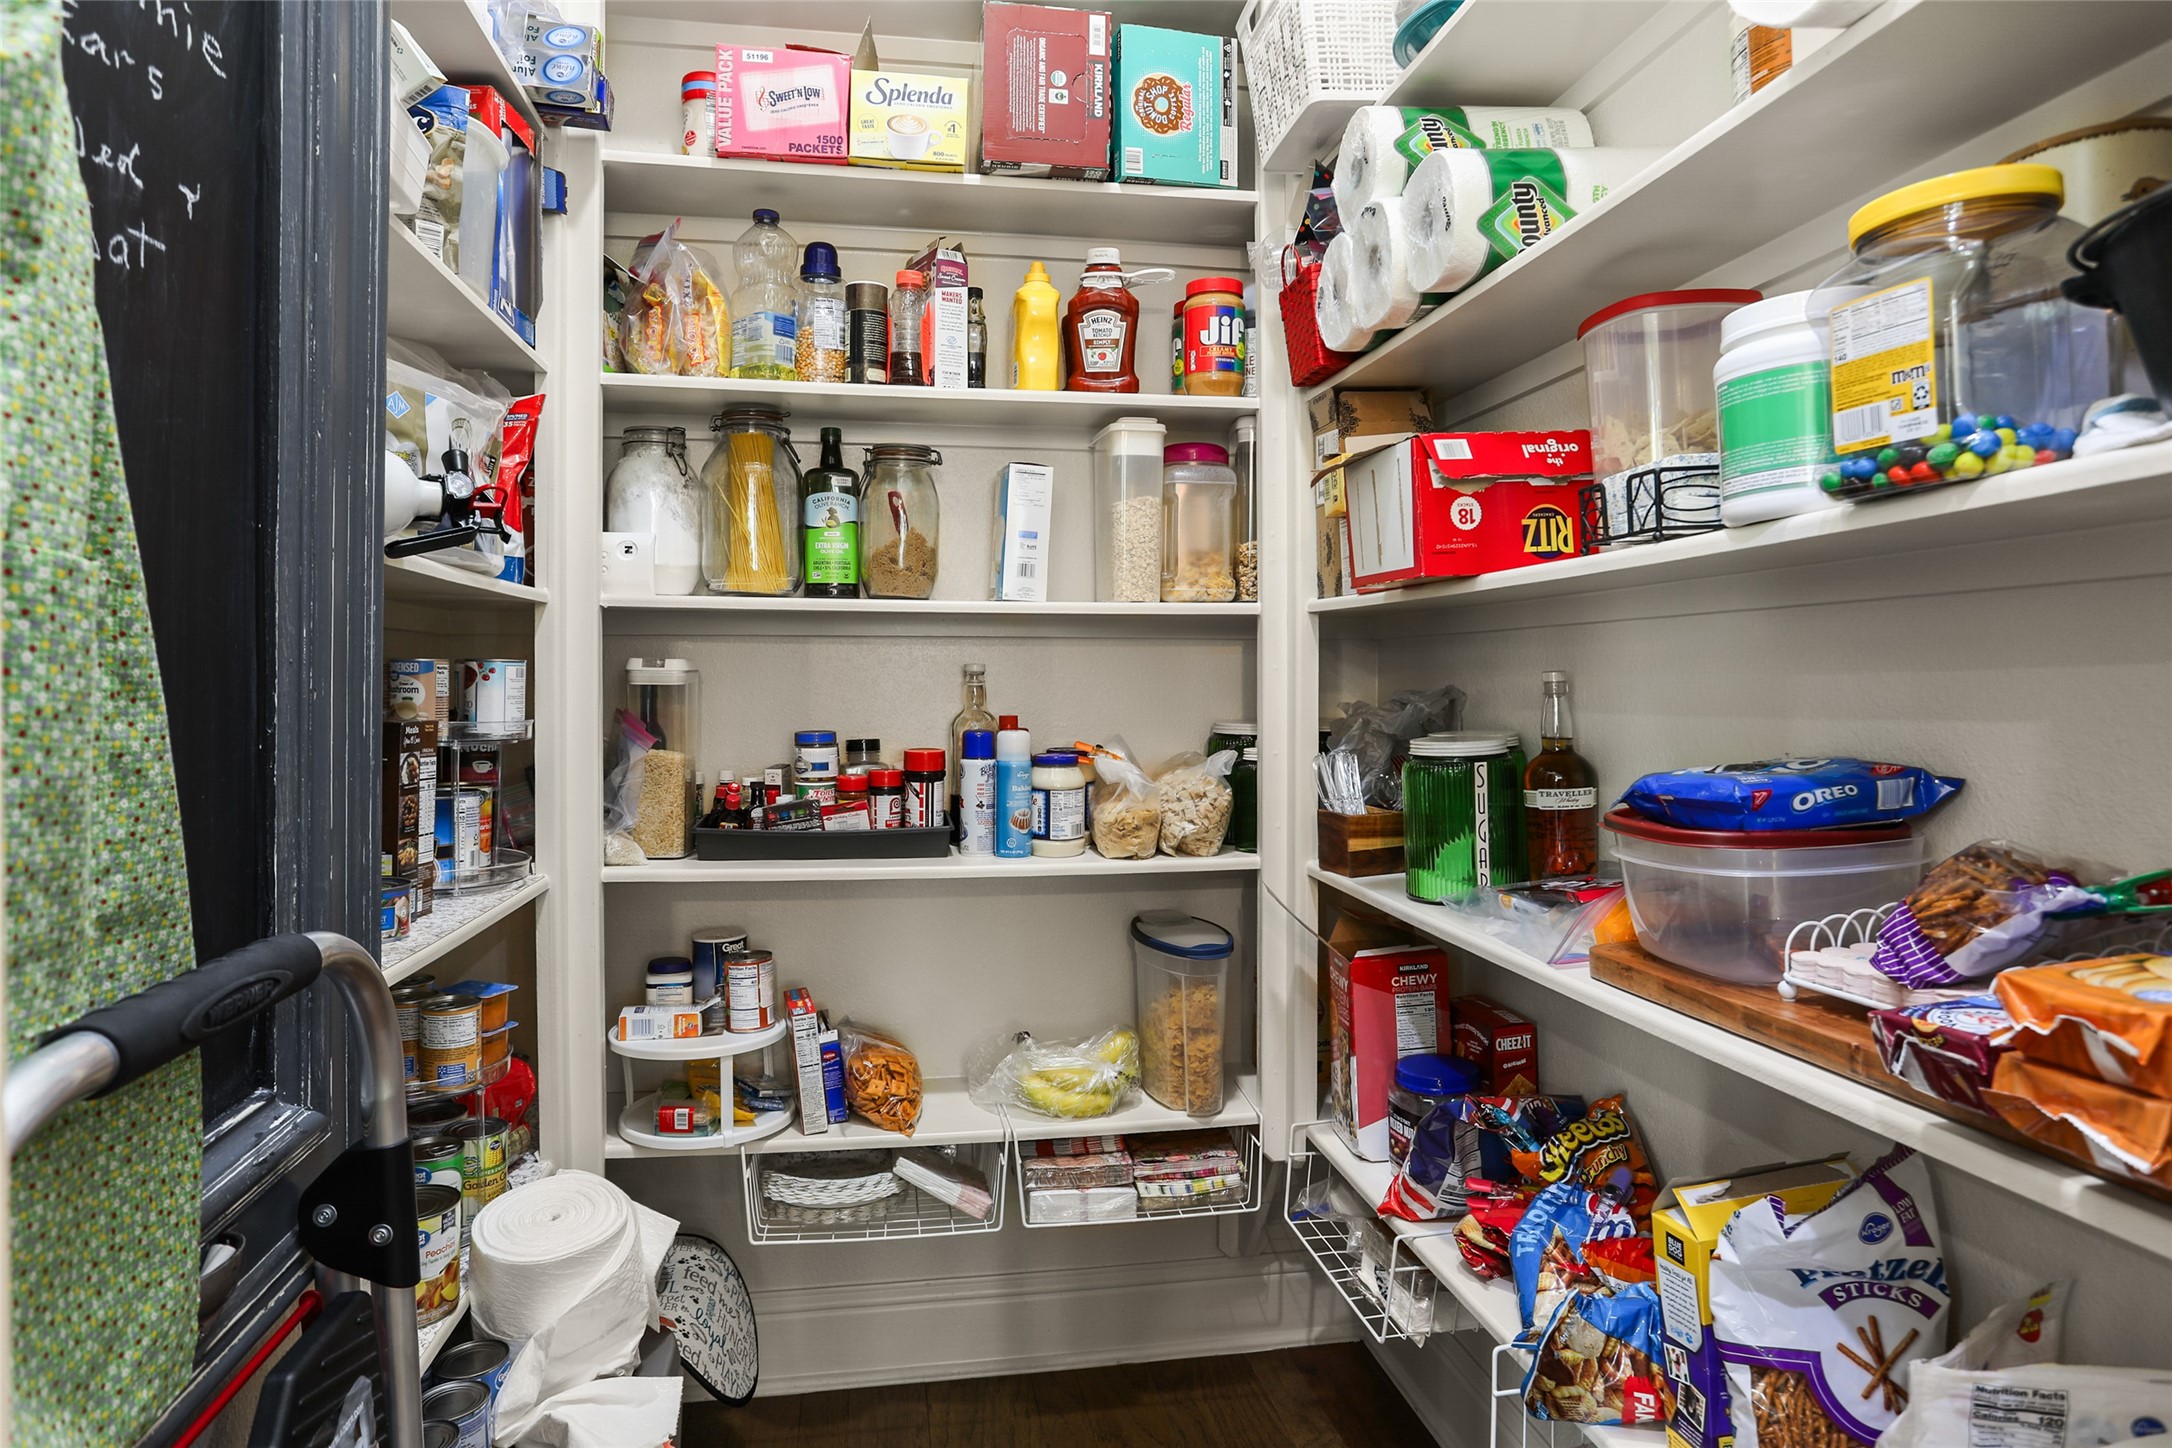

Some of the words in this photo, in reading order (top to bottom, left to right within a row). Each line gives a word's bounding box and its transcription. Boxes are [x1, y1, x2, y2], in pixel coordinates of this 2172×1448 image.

[746, 53, 769, 61] 51196
[718, 49, 733, 93] PACK
[865, 77, 953, 107] Splenda
[1095, 63, 1104, 118] KIRKLAND
[1146, 85, 1169, 101] SHOP
[1143, 101, 1168, 124] DONUT
[1179, 82, 1195, 132] Regular
[717, 97, 733, 147] VALUE
[816, 135, 844, 145] 1500
[788, 142, 843, 155] PACKETS
[941, 290, 962, 299] MAKERS
[941, 296, 963, 305] WANTED
[1091, 316, 1113, 325] HEINZ
[1200, 315, 1245, 346] Jif
[1521, 438, 1579, 458] original
[1546, 457, 1564, 467] the
[812, 495, 852, 506] CALIFORNIA
[814, 502, 830, 510] OLIVE
[829, 502, 850, 510] RANCH
[1457, 508, 1476, 525] 18
[1521, 515, 1574, 554] RITZ
[1538, 789, 1593, 798] TRAVELLER
[1792, 785, 1858, 811] OREO
[722, 941, 744, 953] Great
[1391, 973, 1438, 987] CHEWY
[1392, 985, 1420, 993] PROTEIN
[1893, 1197, 1912, 1214] LOW
[1900, 1210, 1916, 1224] FAT
[1861, 1222, 1891, 1238] Kroger
[425, 1241, 456, 1259] Peaches
[1667, 1236, 1682, 1249] BLUE
[1668, 1243, 1683, 1257] DOG
[682, 1266, 718, 1295] feed
[1833, 1281, 1923, 1308] STICKS
[718, 1290, 736, 1319] me
[695, 1308, 727, 1357] loyal
[1975, 1385, 2028, 1398] Nutrition
[2032, 1390, 2066, 1401] Facts
[1973, 1411, 2019, 1422] Calories
[2038, 1416, 2064, 1428] 120
